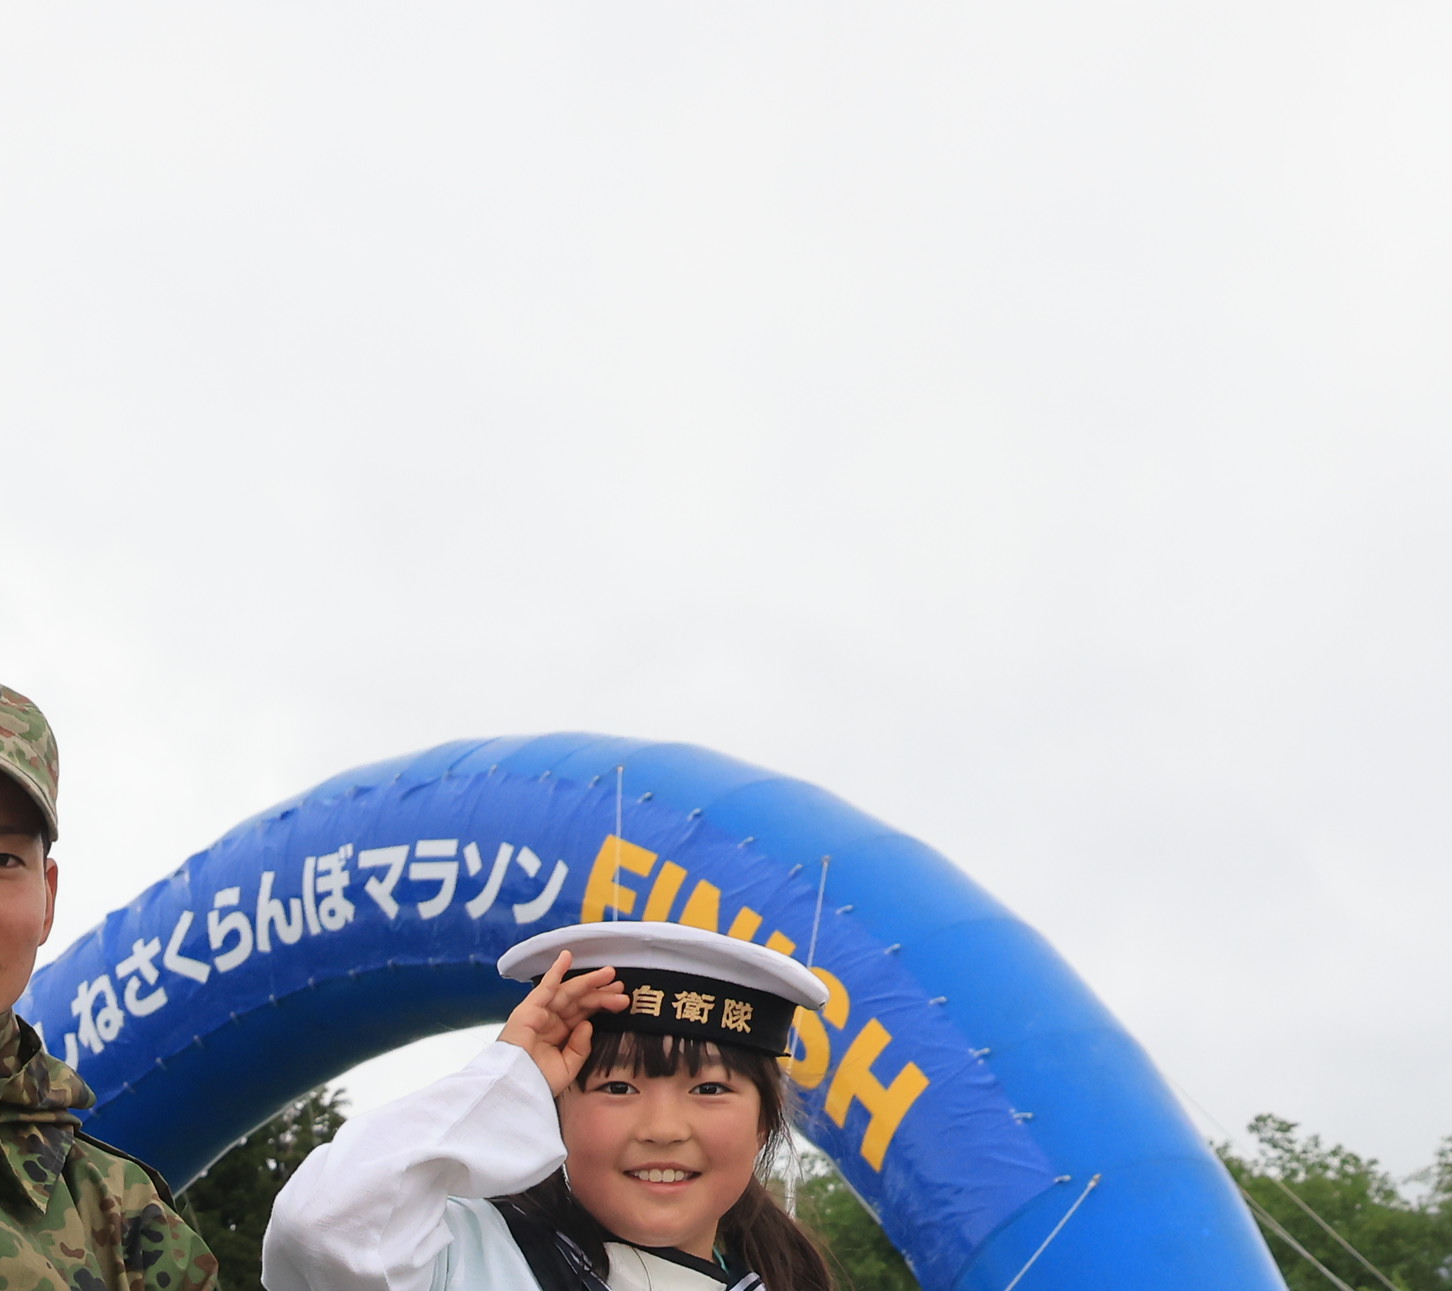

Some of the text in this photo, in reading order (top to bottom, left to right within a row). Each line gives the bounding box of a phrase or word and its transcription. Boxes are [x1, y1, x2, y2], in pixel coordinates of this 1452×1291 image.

[581, 834, 930, 1172] FINSH
[630, 984, 754, 1034] 自衛隊
